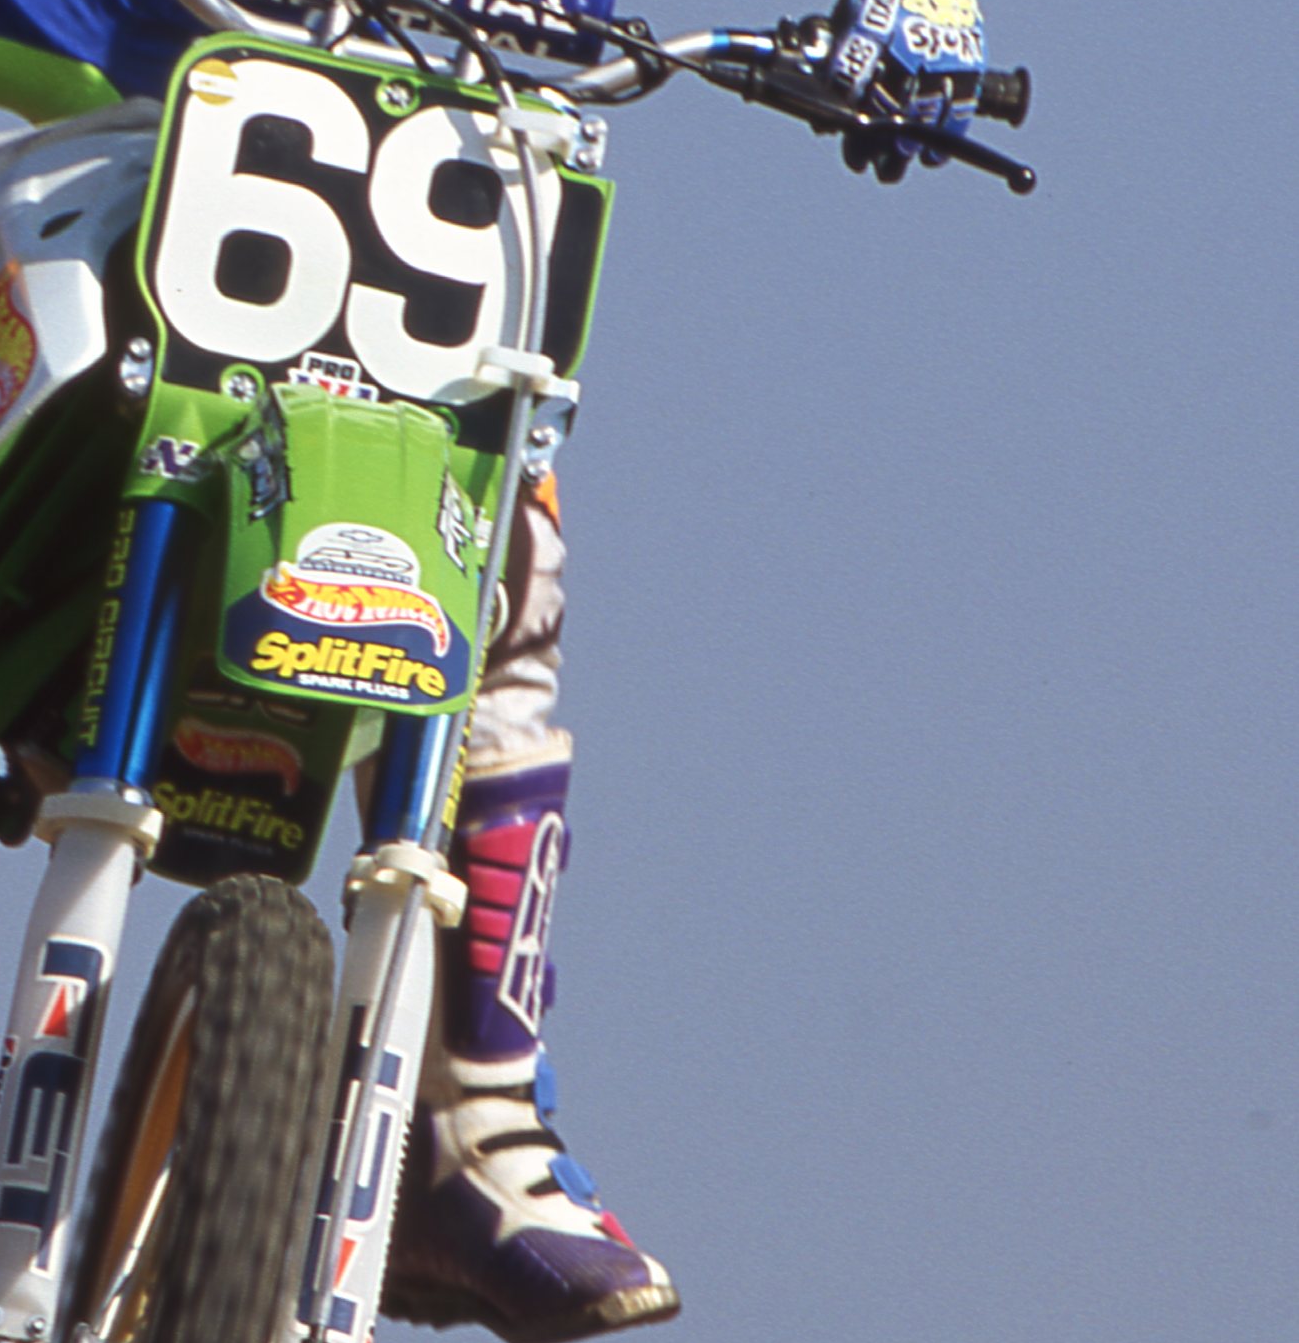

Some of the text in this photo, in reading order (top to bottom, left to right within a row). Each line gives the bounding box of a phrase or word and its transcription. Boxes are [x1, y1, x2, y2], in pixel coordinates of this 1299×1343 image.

[904, 15, 985, 65] SPORT
[154, 57, 563, 405] 69
[307, 356, 355, 380] PRO
[251, 630, 447, 698] SplitFire
[298, 672, 410, 701] SPARK PLUGS
[152, 781, 305, 851] SplitFire
